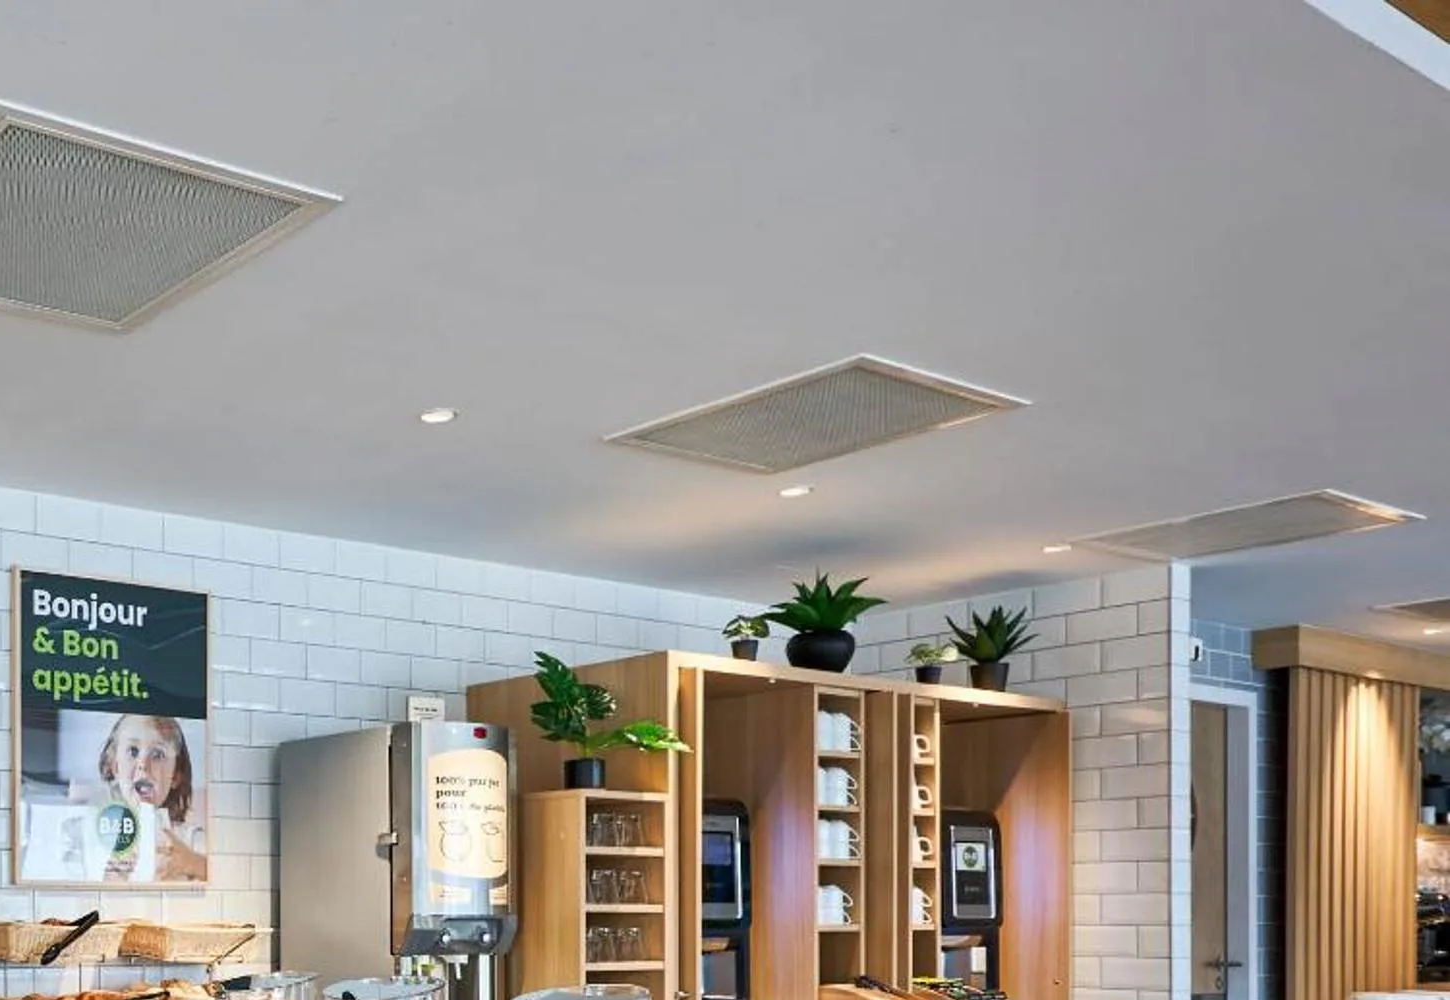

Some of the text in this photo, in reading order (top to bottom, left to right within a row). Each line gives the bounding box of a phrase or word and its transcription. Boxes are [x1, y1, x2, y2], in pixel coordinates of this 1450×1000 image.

[33, 589, 148, 631] Bonjour
[32, 626, 118, 660] & Bon
[32, 666, 149, 702] appétit.
